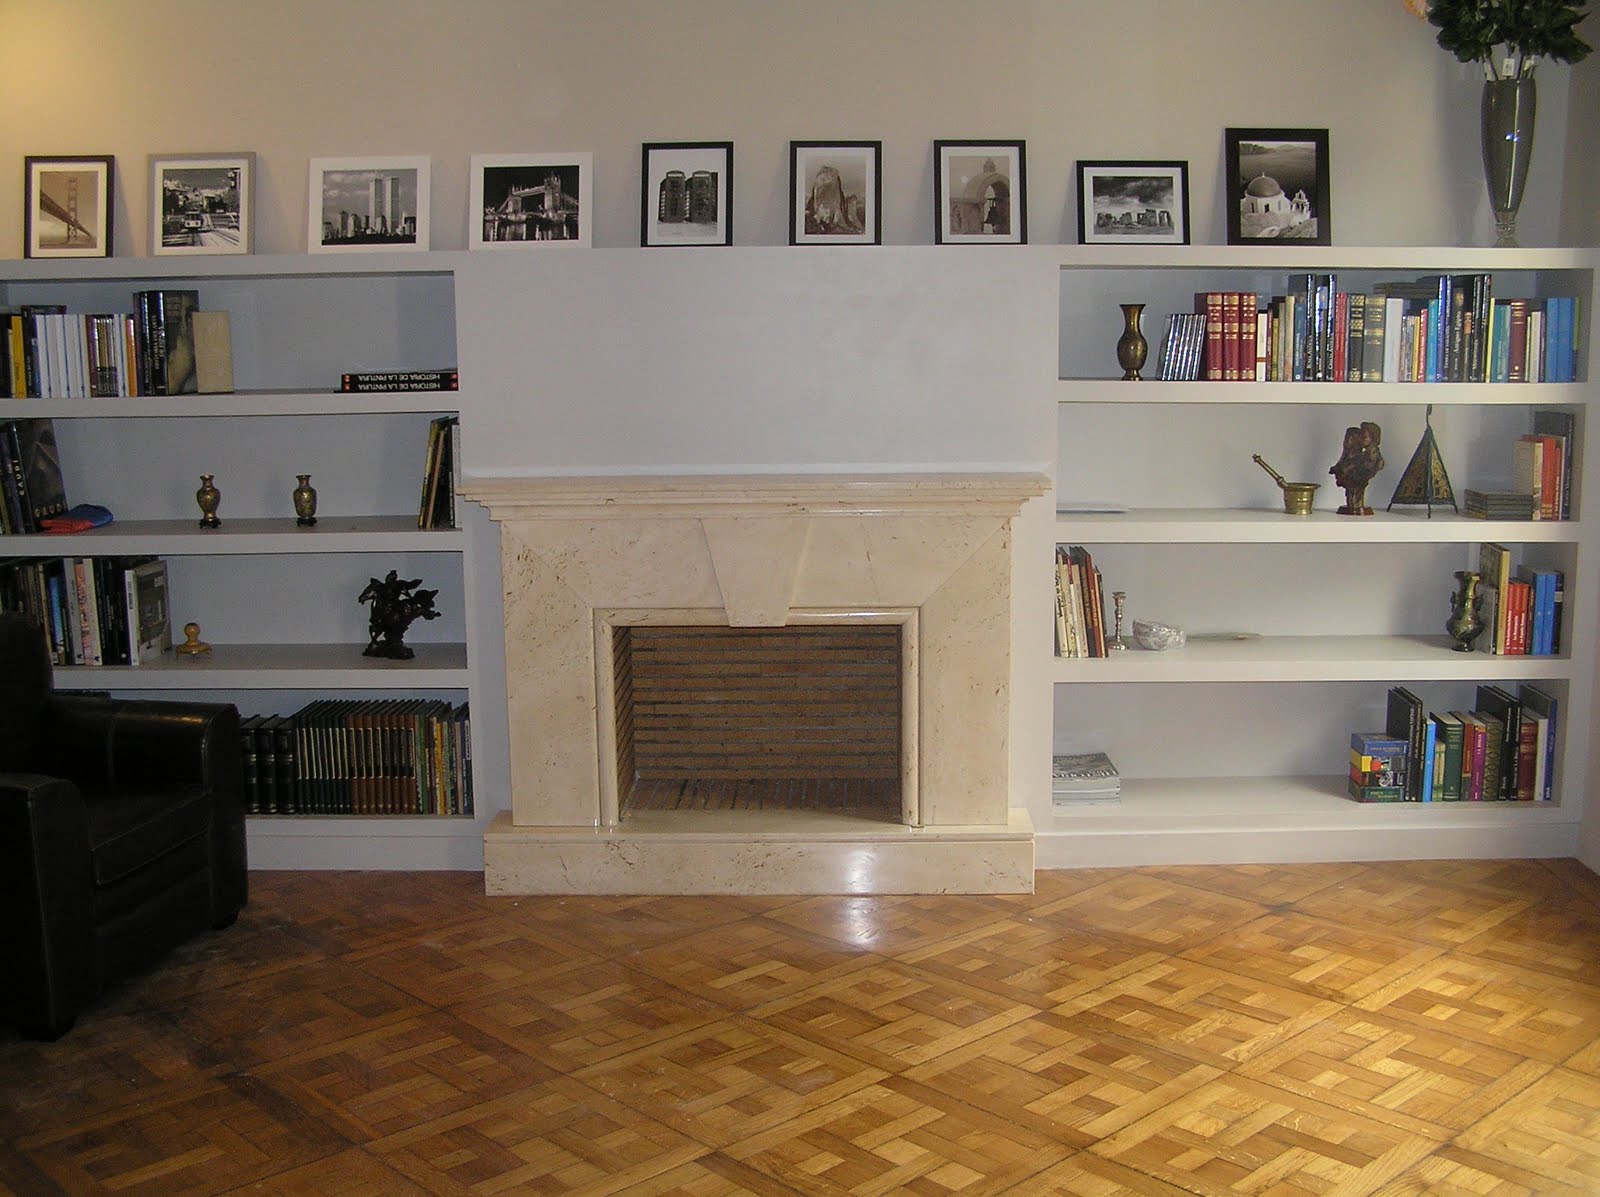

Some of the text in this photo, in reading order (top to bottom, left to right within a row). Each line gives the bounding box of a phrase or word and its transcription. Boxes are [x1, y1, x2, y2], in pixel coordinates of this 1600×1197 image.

[358, 382, 440, 390] HISTORIA DE LA PINTURA
